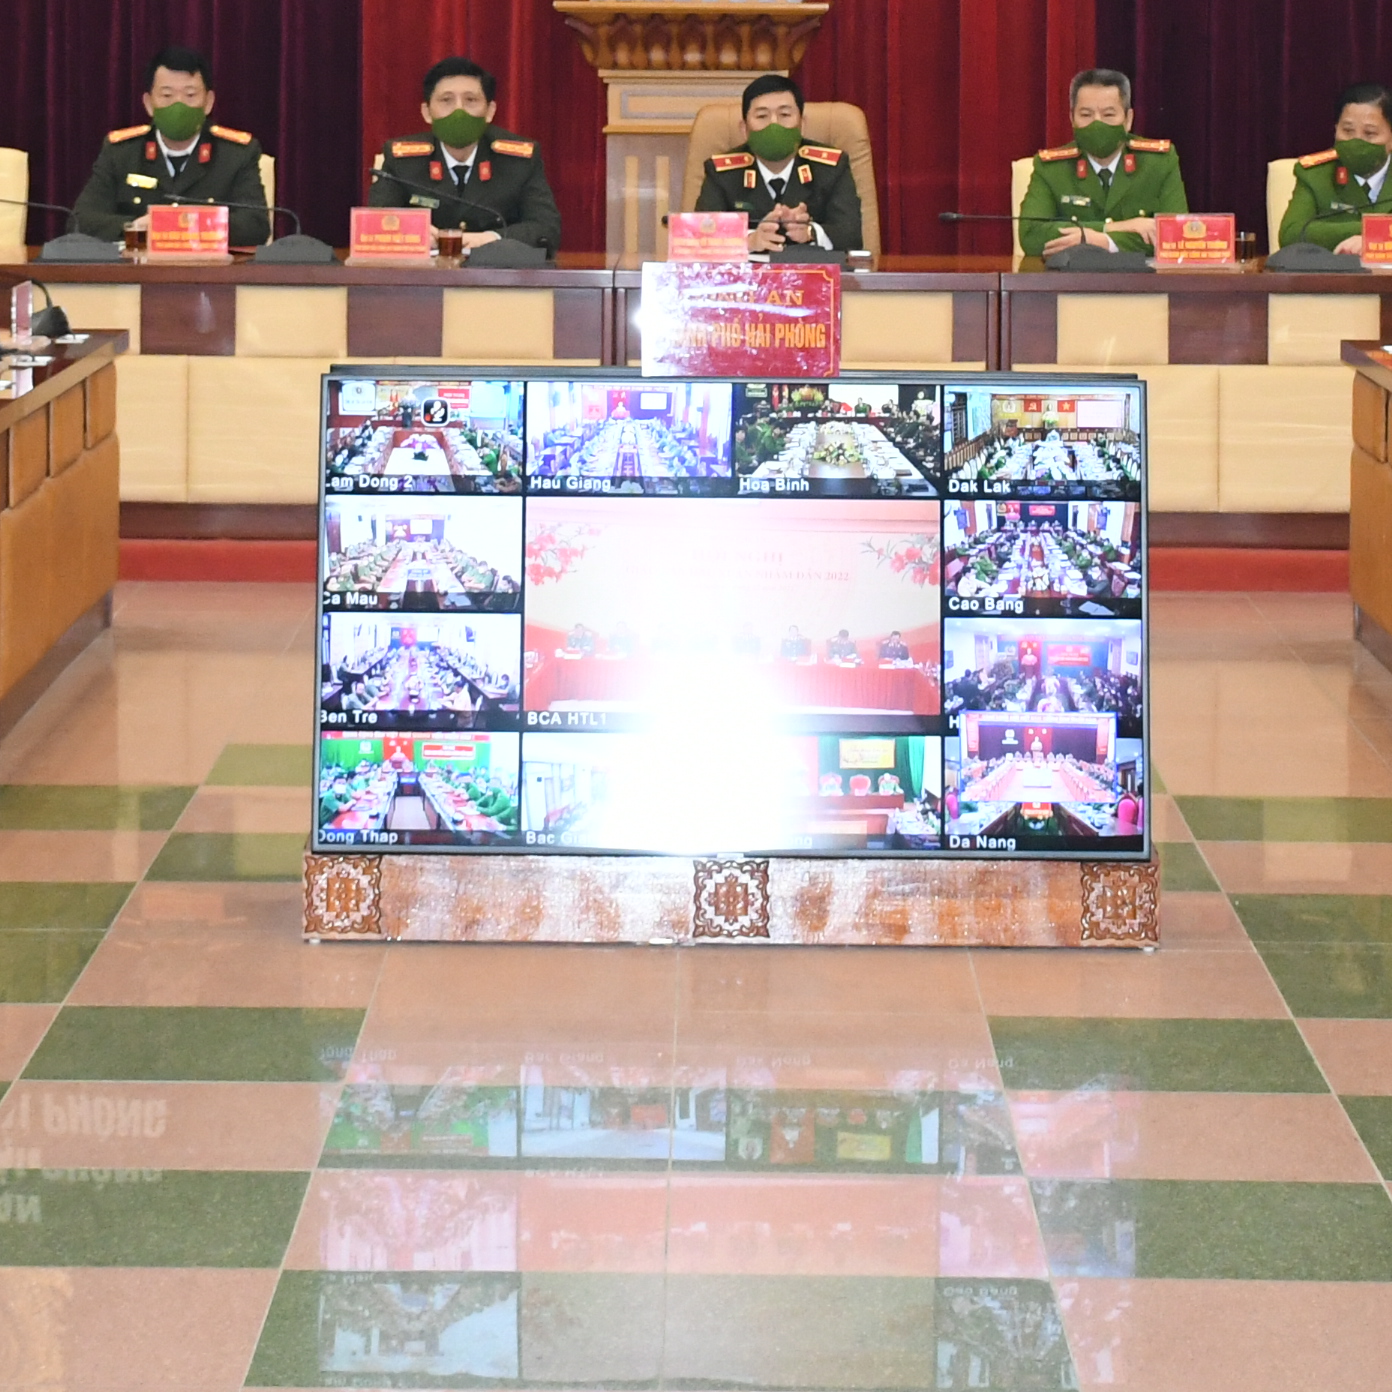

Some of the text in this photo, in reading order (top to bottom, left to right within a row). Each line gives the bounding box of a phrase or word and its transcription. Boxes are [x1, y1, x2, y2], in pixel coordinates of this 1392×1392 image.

[766, 290, 804, 305] AN
[775, 317, 826, 348] PHÒNG
[359, 474, 399, 491] Dong
[404, 474, 413, 489] 2
[530, 476, 612, 493] Hau Giang
[739, 477, 810, 492] Hoa Binh
[948, 479, 1011, 494] Dak Lak
[346, 591, 378, 605] Mau
[948, 596, 1024, 614] Cao Bang
[352, 710, 378, 724] Tre
[527, 711, 606, 726] BCA HTL1
[360, 830, 398, 845] Thap
[526, 830, 555, 845] Bac
[949, 834, 1016, 850] Da Nang
